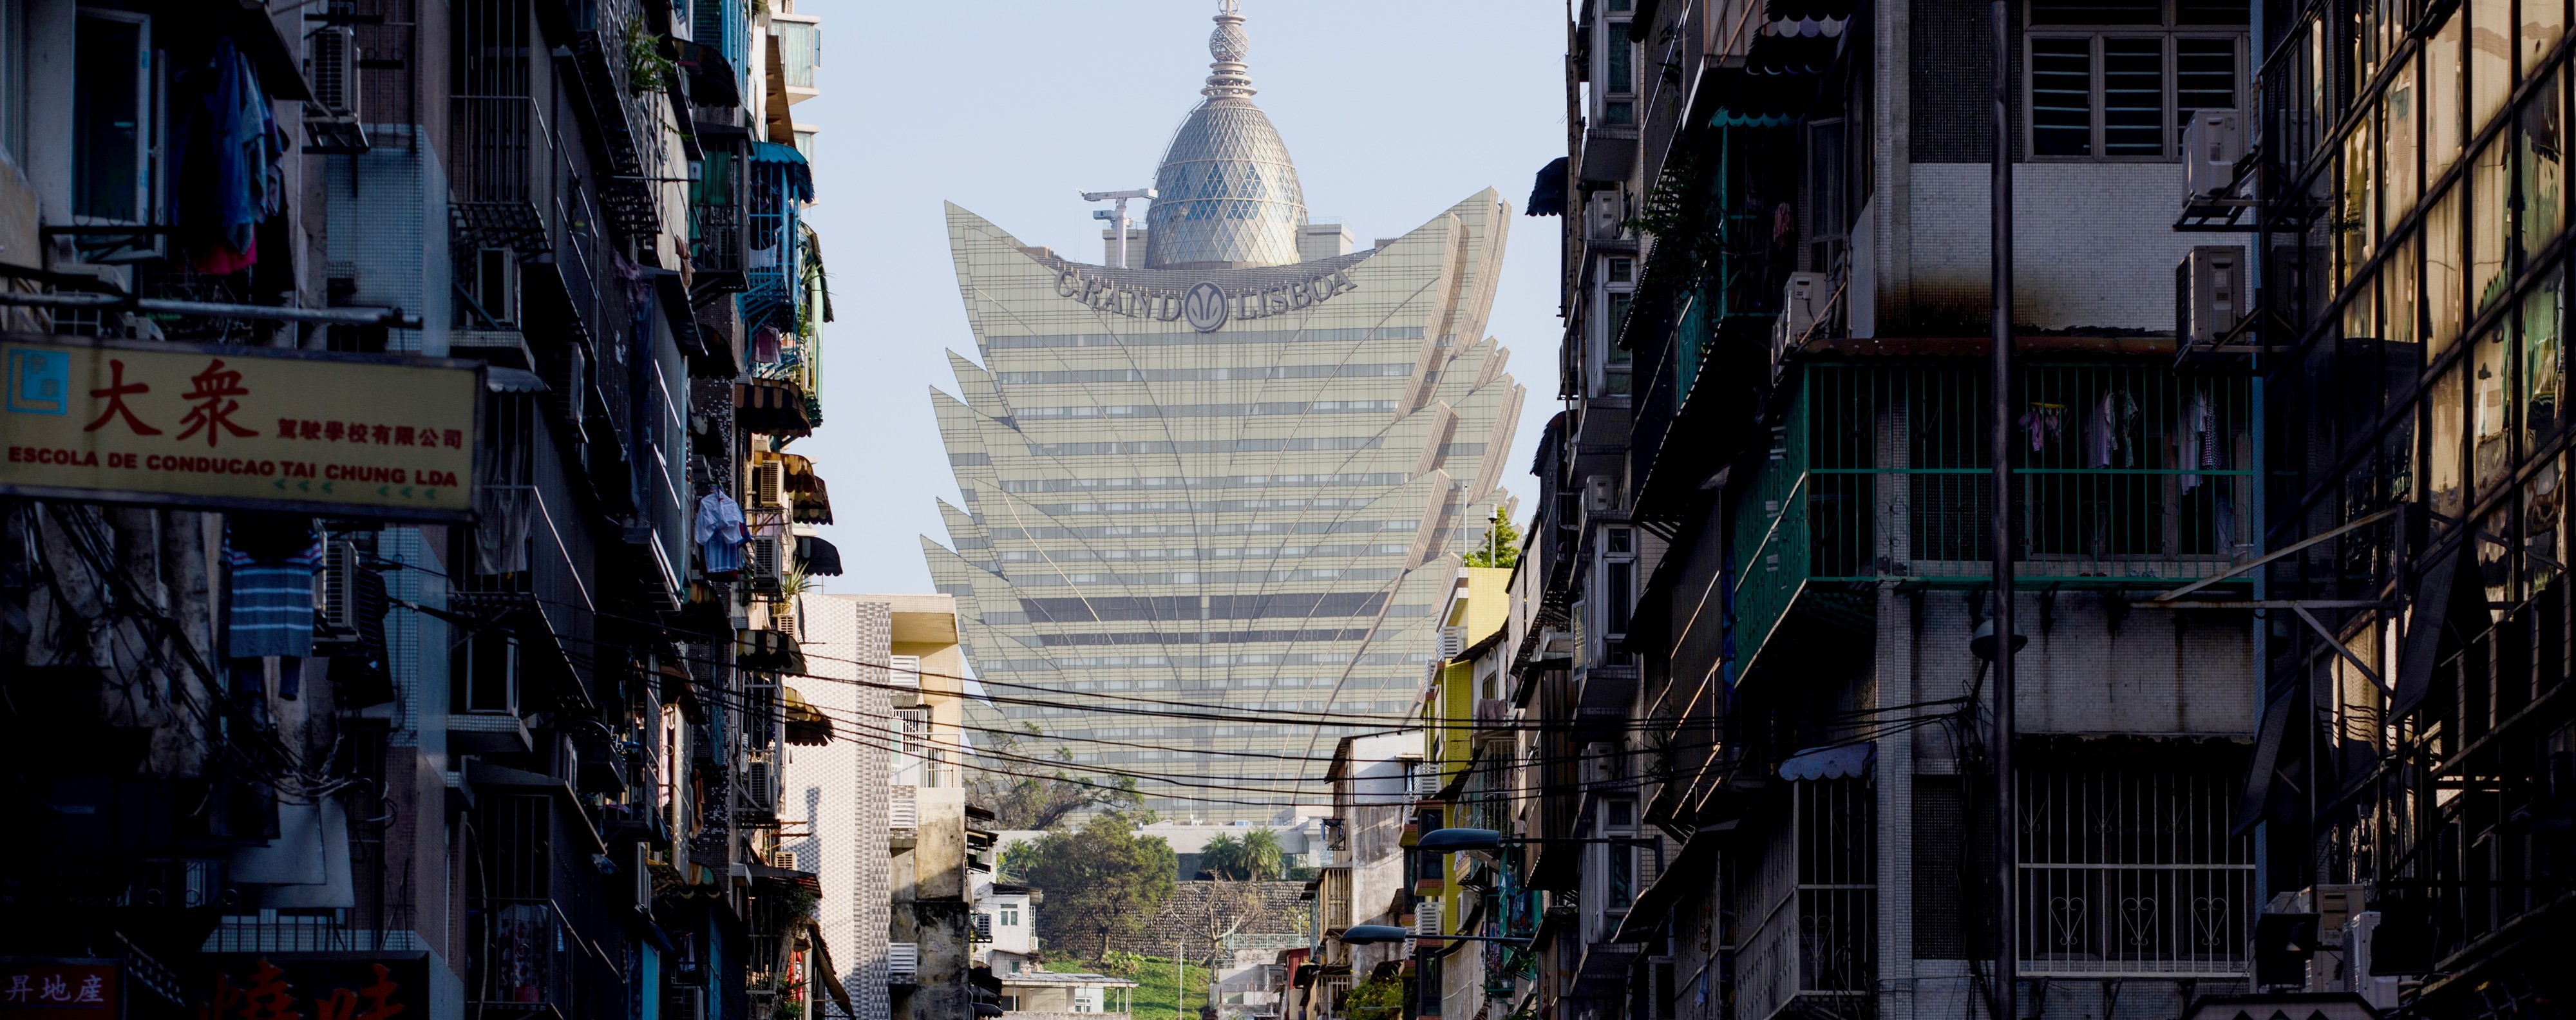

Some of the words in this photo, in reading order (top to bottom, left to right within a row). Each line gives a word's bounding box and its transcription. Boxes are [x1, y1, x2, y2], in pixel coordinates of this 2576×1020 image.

[1054, 269, 1182, 322] GRAND
[1235, 264, 1358, 320] LISBOA
[278, 419, 462, 449] 駕駛學校有限公司
[8, 446, 99, 467] ESCOLA
[108, 453, 138, 469] DE
[147, 455, 275, 477] CONDUCAO
[280, 461, 316, 477] TAI
[325, 464, 406, 484] CHUNG
[415, 469, 458, 487] LDA
